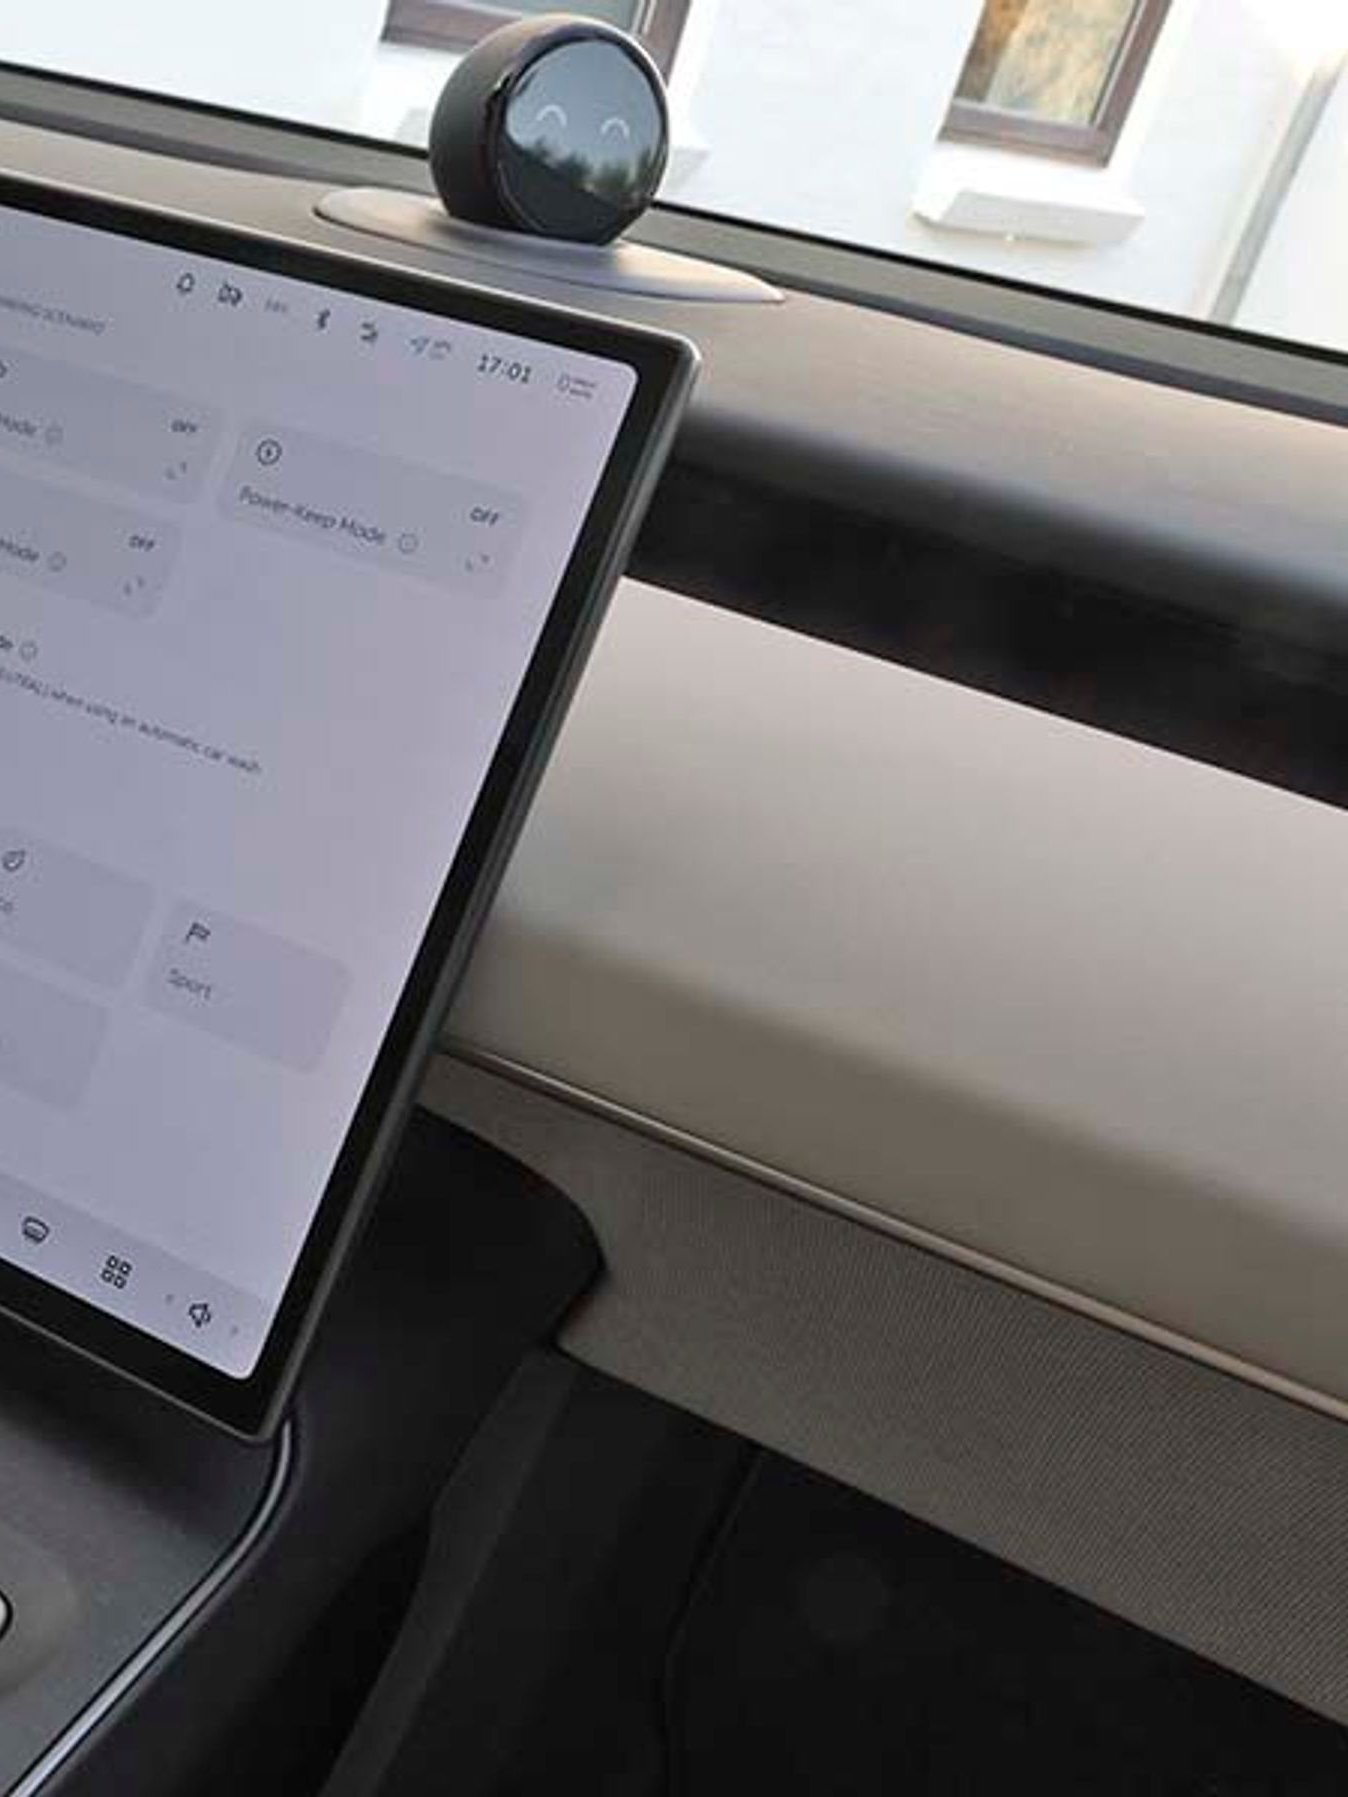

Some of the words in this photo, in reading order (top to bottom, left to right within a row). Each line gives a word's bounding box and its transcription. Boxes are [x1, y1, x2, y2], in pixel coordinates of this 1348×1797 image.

[477, 353, 532, 384] 17:01
[339, 516, 388, 544] Mode
[168, 968, 212, 1000] Sport
